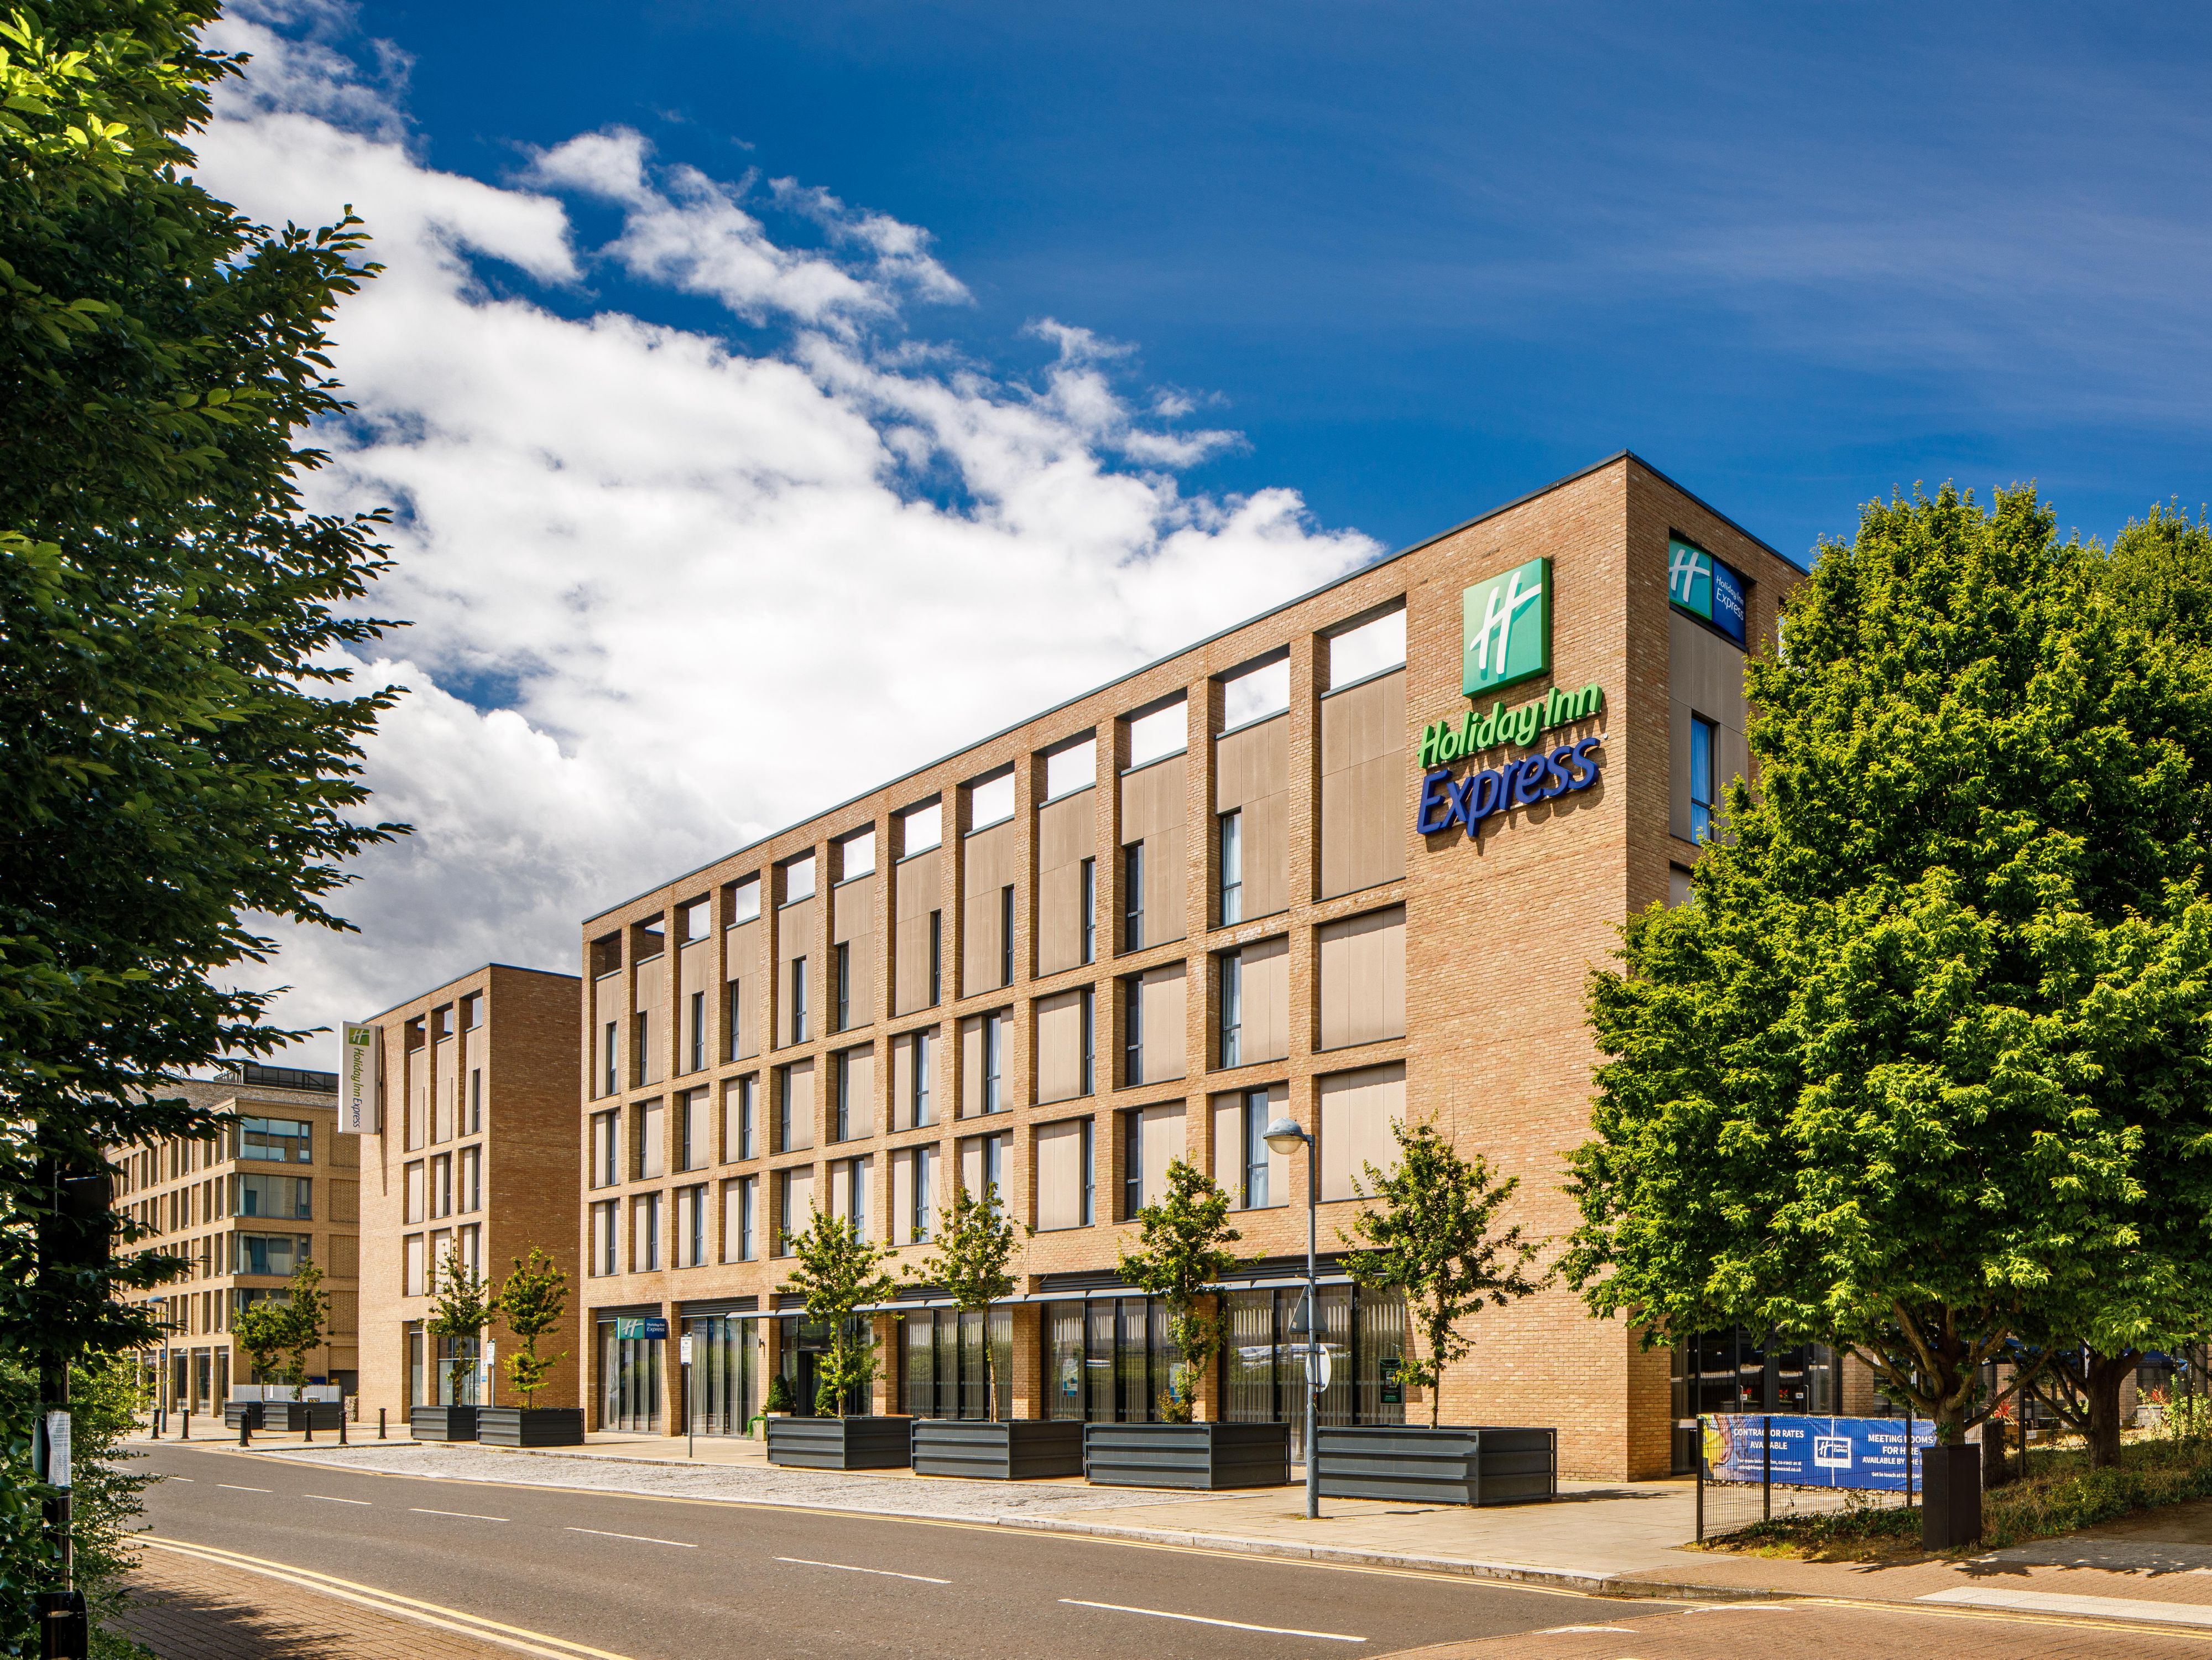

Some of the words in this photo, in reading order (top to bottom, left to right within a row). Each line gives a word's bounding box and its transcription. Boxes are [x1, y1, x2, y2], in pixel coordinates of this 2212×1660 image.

[1716, 575, 1736, 600] Holiday
[1717, 587, 1744, 621] Express
[1417, 701, 1544, 768] Holiday
[1544, 683, 1602, 728] Inn
[1417, 737, 1600, 837] Express
[351, 1047, 364, 1083] Holiday
[353, 1083, 364, 1097] Inn
[351, 1097, 362, 1128] Express
[1734, 1428, 1781, 1437] CONTRACOR
[1782, 1430, 1804, 1438] RATES
[1867, 1434, 1902, 1443] MEETING
[1750, 1441, 1787, 1449] AVAABLE
[1882, 1446, 1898, 1455] FOR
[1900, 1446, 1918, 1455] HRE
[1863, 1456, 1896, 1465] AVAILABLE
